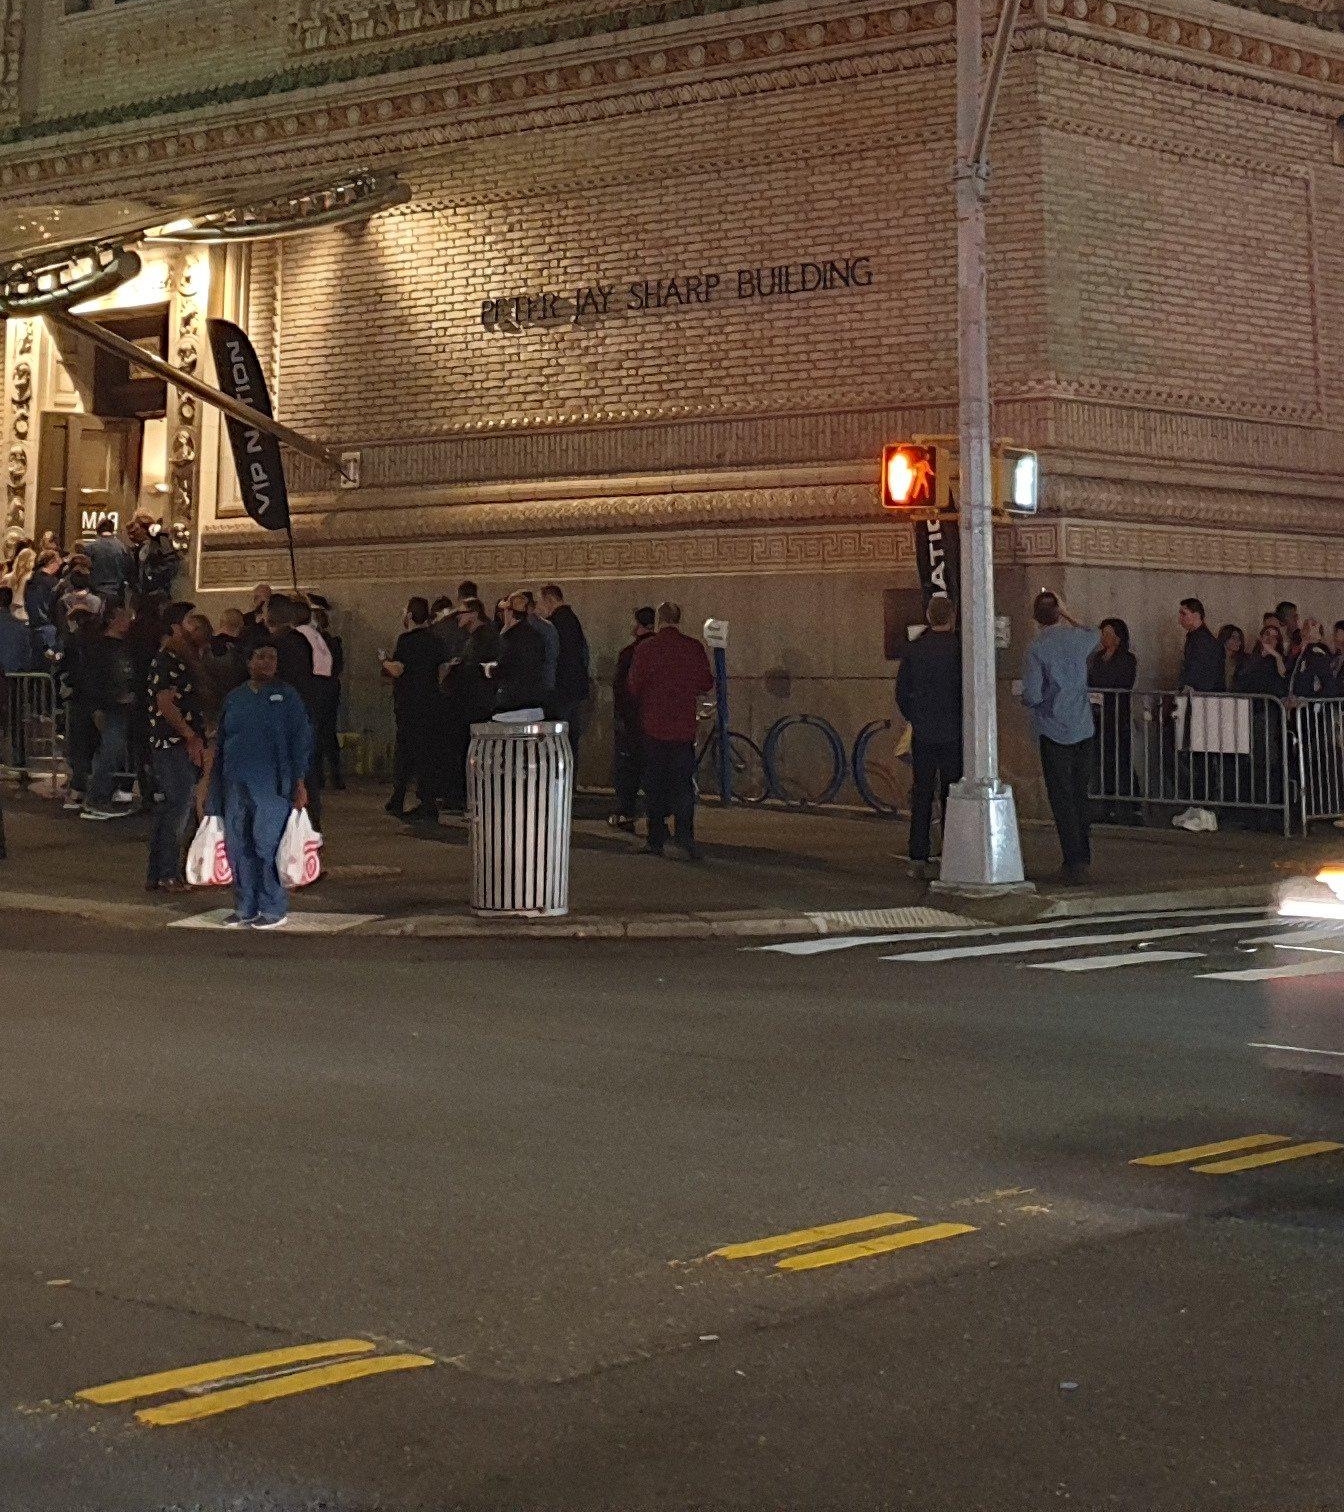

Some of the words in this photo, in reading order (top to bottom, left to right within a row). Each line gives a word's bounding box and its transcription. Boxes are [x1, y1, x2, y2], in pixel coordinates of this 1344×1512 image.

[481, 292, 561, 326] PETER
[573, 285, 613, 322] JAY
[627, 273, 720, 310] SHARP
[737, 256, 873, 298] BUILDING
[227, 340, 263, 455] NTION
[250, 462, 271, 515] VIP
